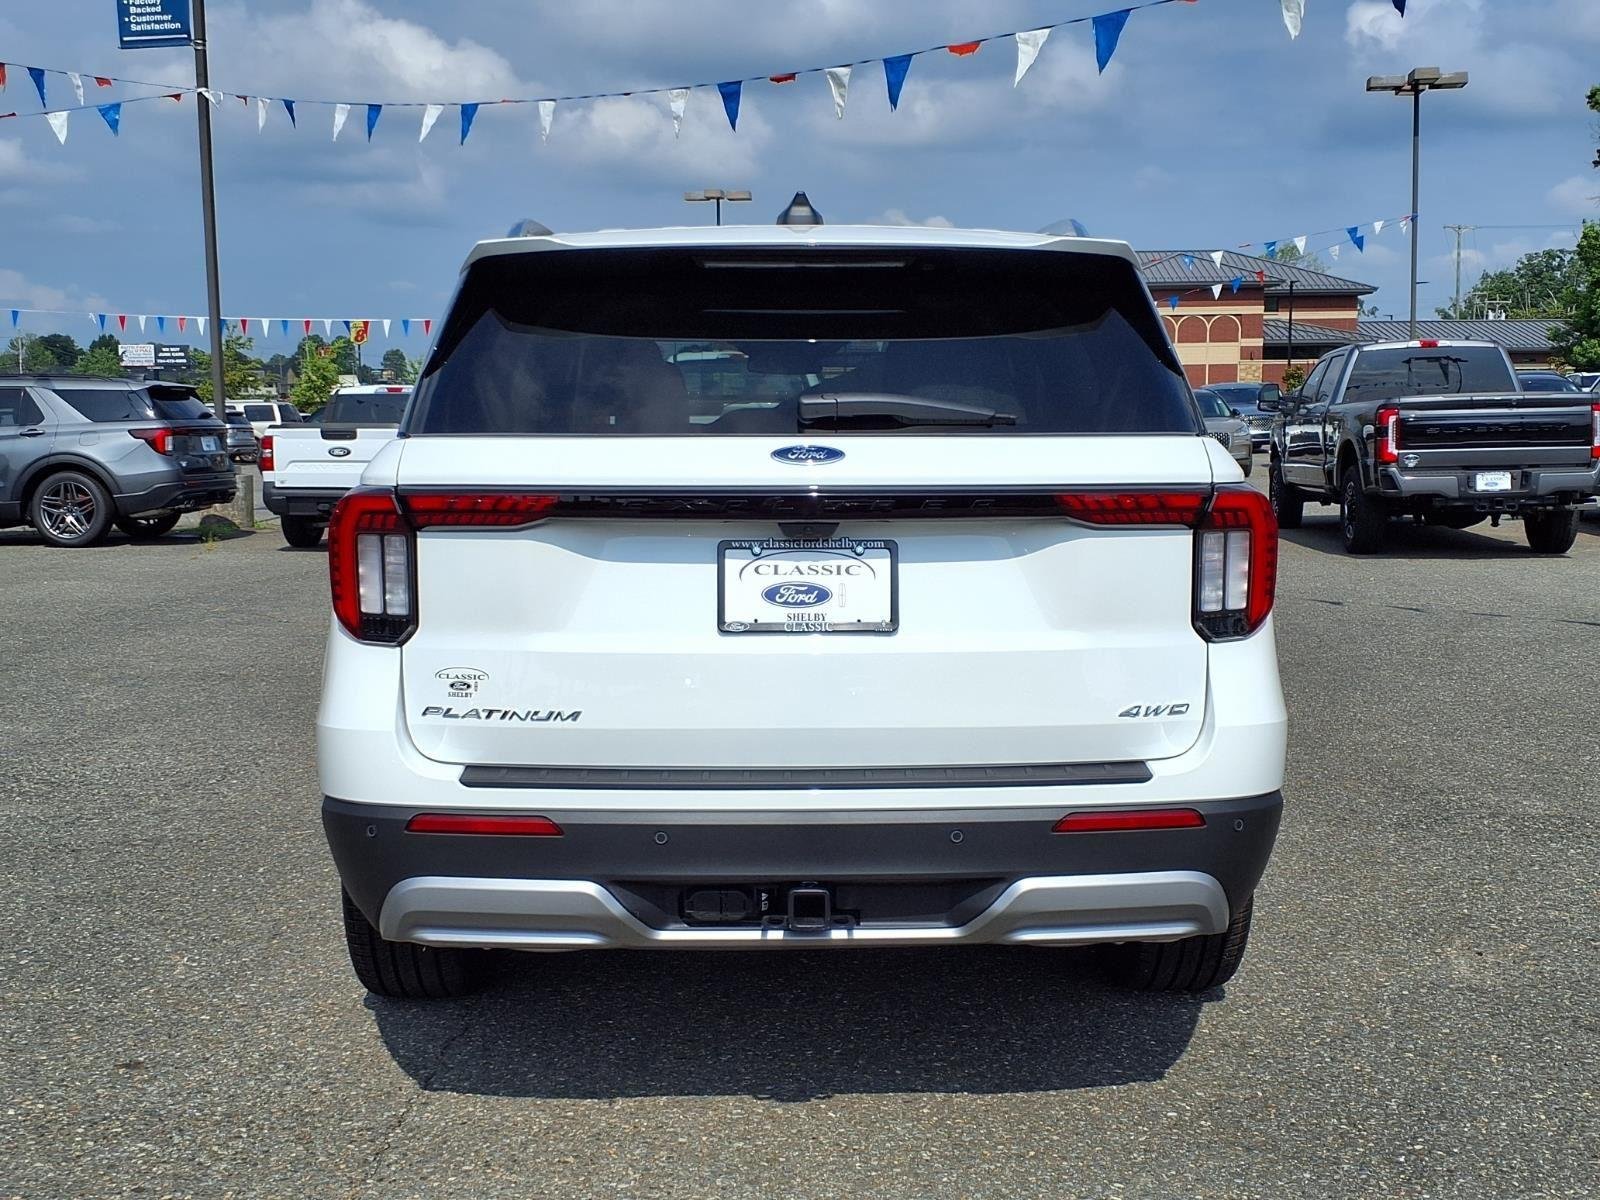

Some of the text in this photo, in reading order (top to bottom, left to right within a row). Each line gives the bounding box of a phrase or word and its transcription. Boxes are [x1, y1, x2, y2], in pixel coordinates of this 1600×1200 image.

[129, 5, 161, 14] Backed
[130, 22, 181, 31] Satisfaction
[731, 537, 885, 550] www.classicfordshelby.com
[753, 563, 862, 576] CLASSIC
[775, 584, 819, 604] Ford
[786, 612, 828, 622] SHELBY
[784, 621, 834, 632] CLASSIC
[438, 673, 486, 681] CLASSIC
[421, 706, 583, 722] PLATINUM
[1118, 703, 1190, 718] 4WD
